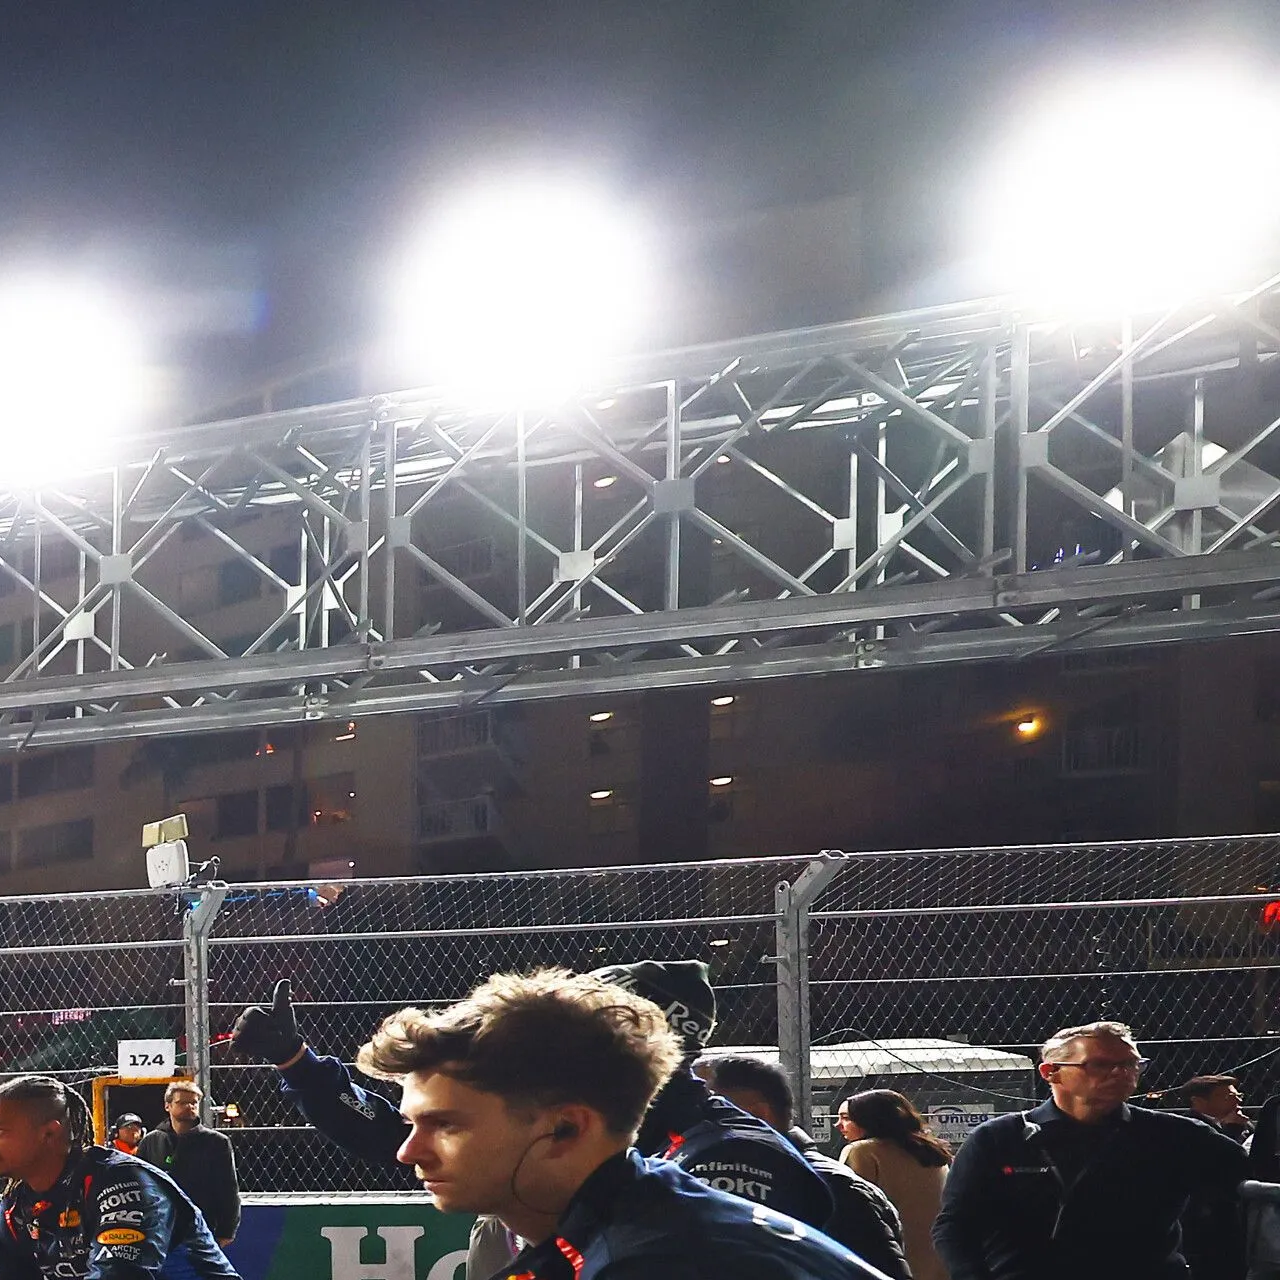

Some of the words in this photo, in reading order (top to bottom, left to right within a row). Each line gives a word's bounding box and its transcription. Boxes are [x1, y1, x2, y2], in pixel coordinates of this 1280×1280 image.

[129, 1054, 165, 1067] 17.4
[340, 1091, 376, 1119] sparco
[99, 1190, 142, 1213] ROKT
[108, 1233, 139, 1241] RAUCH
[111, 1244, 140, 1255] ARCTIC
[115, 1251, 139, 1261] WOLF
